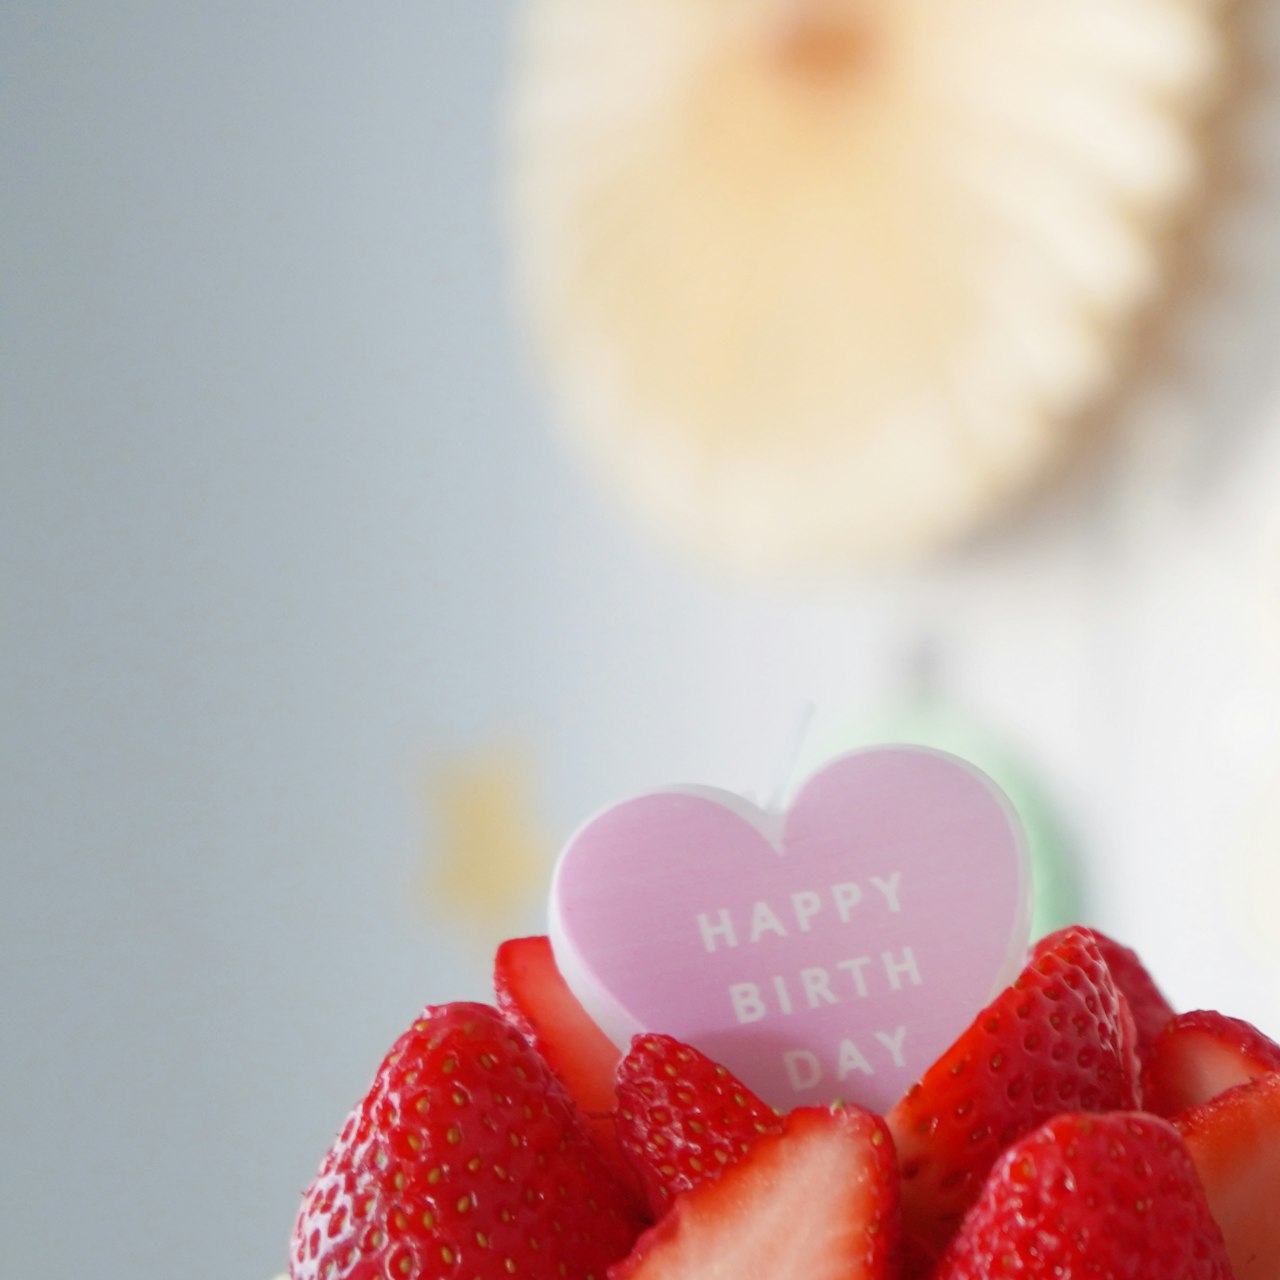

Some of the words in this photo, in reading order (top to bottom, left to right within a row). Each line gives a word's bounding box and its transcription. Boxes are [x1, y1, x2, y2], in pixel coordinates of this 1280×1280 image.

[696, 871, 903, 953] HAPPY
[728, 946, 923, 1025] BIRTH
[784, 1025, 908, 1092] DAY
